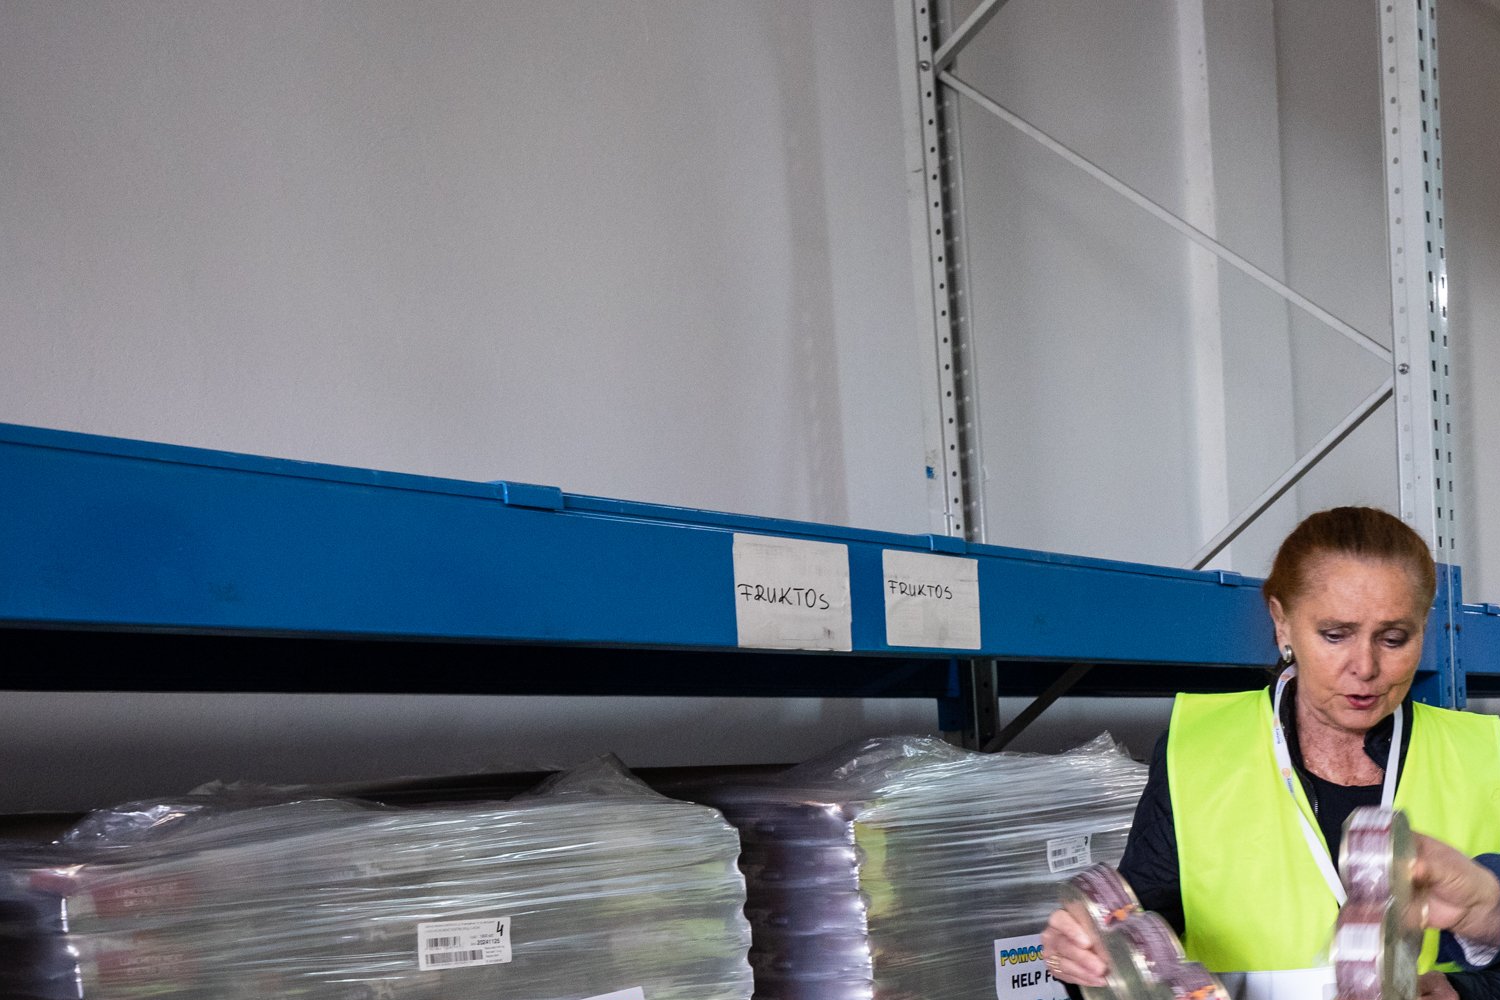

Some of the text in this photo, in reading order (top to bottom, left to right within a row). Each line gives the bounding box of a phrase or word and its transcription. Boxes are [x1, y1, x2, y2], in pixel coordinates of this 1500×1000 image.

[737, 583, 830, 610] FRUKTOS
[888, 580, 953, 600] FRUKTOS
[496, 921, 504, 936] 4
[1011, 970, 1041, 990] HELP
